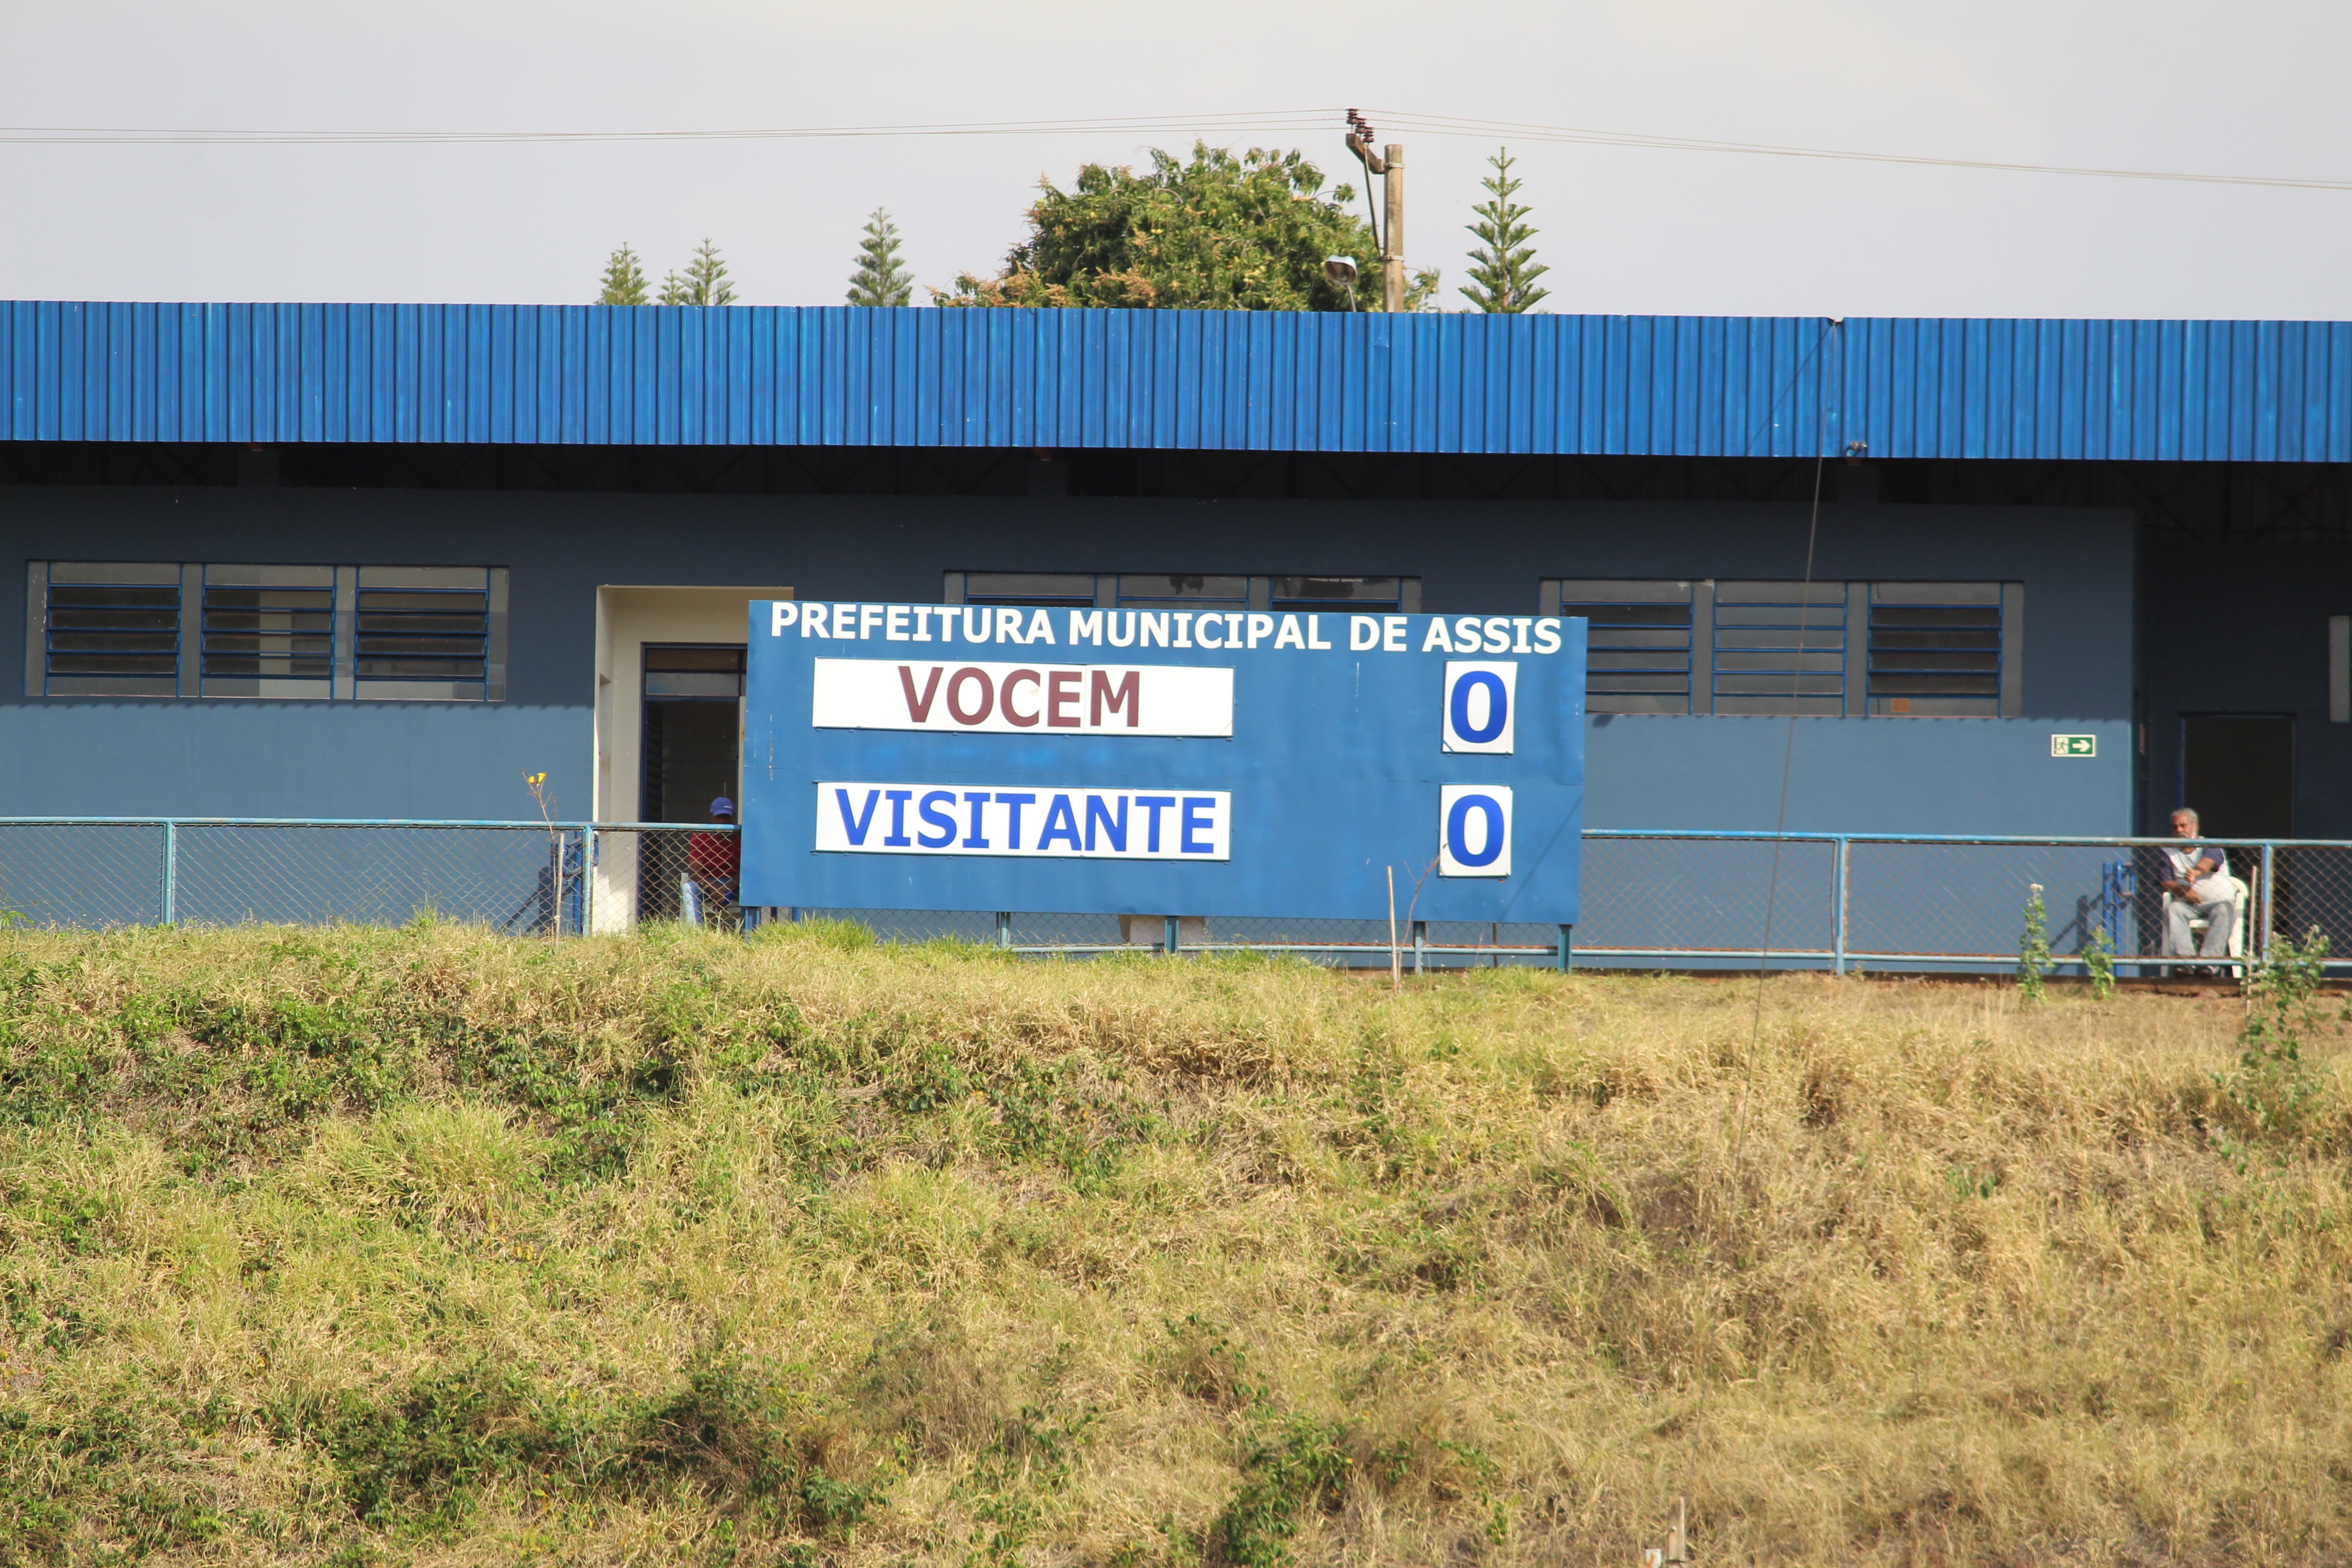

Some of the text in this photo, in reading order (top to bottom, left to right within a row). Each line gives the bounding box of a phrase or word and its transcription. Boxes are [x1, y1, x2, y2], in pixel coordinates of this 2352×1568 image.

[772, 602, 1560, 654] PREFEITURA MUNICIPAL DE ASSIS
[898, 666, 1140, 728] VOCEM
[1450, 671, 1507, 743] 0
[834, 789, 1216, 853] VISITANTE
[1447, 794, 1504, 867] 0
